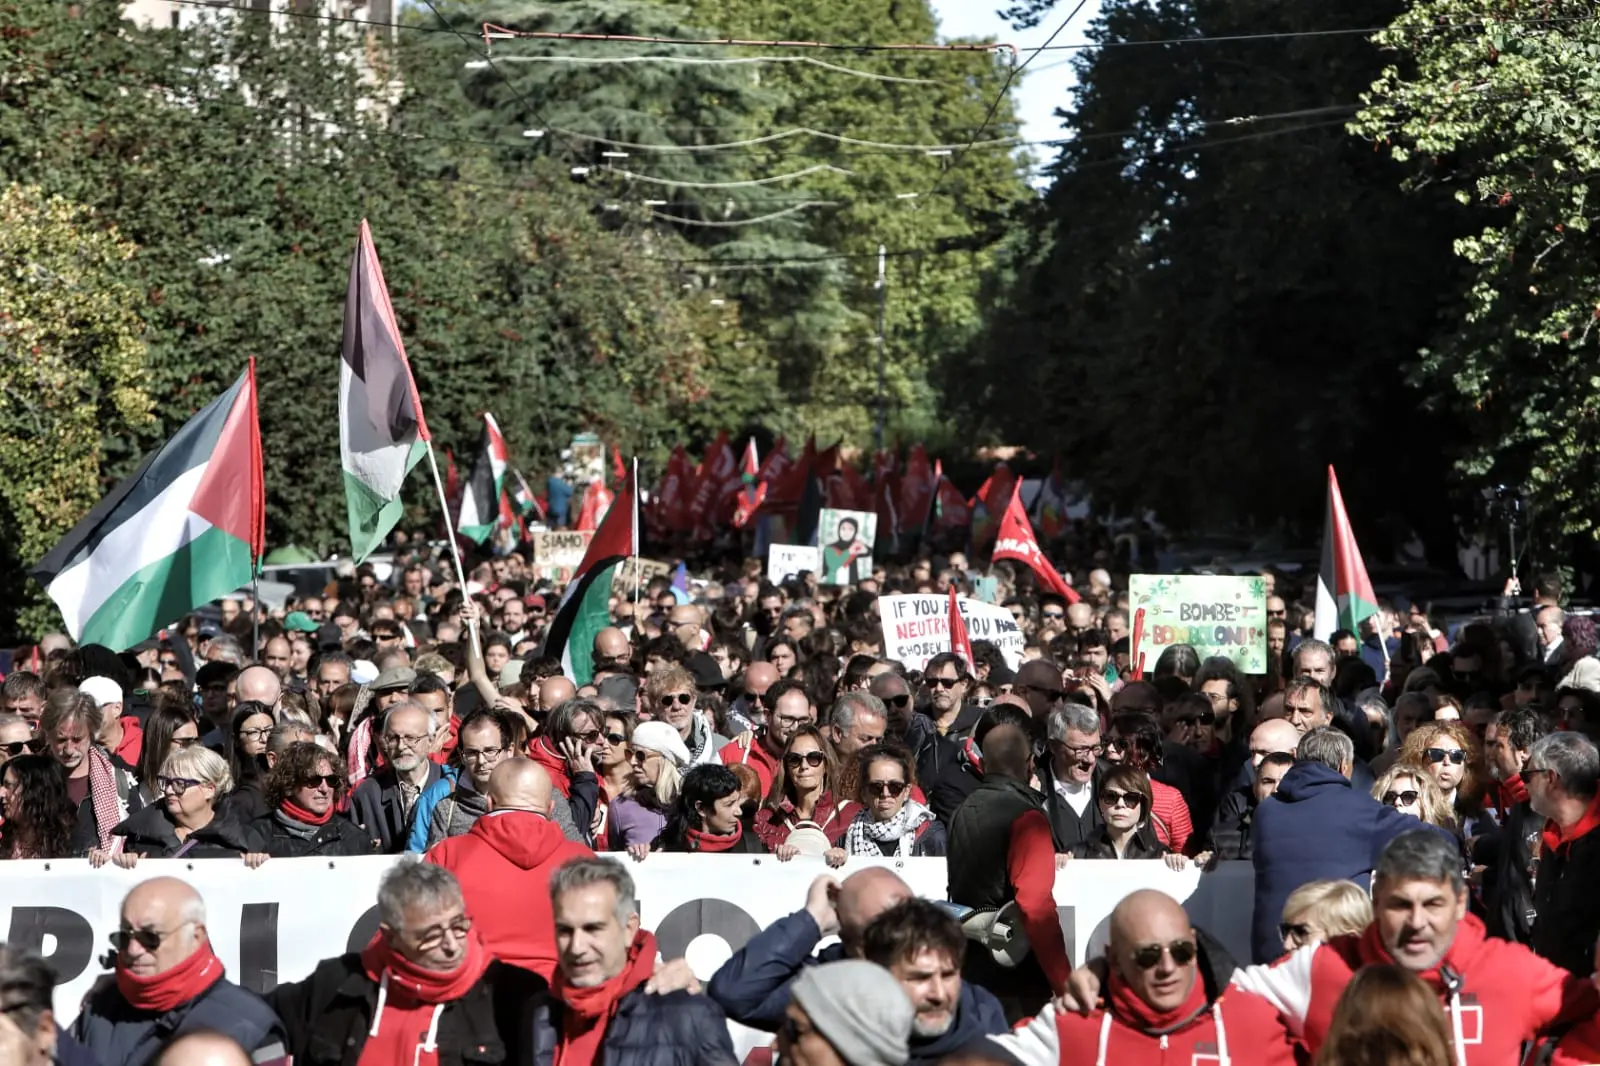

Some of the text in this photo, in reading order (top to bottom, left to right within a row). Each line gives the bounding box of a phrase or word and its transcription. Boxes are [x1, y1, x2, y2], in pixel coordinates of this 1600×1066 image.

[541, 533, 582, 549] SIAMO
[892, 600, 907, 619] IF
[912, 599, 939, 615] YOU
[1180, 602, 1236, 621] BOMBE
[896, 618, 949, 640] NEUTRA
[896, 641, 942, 657] CHOSEN
